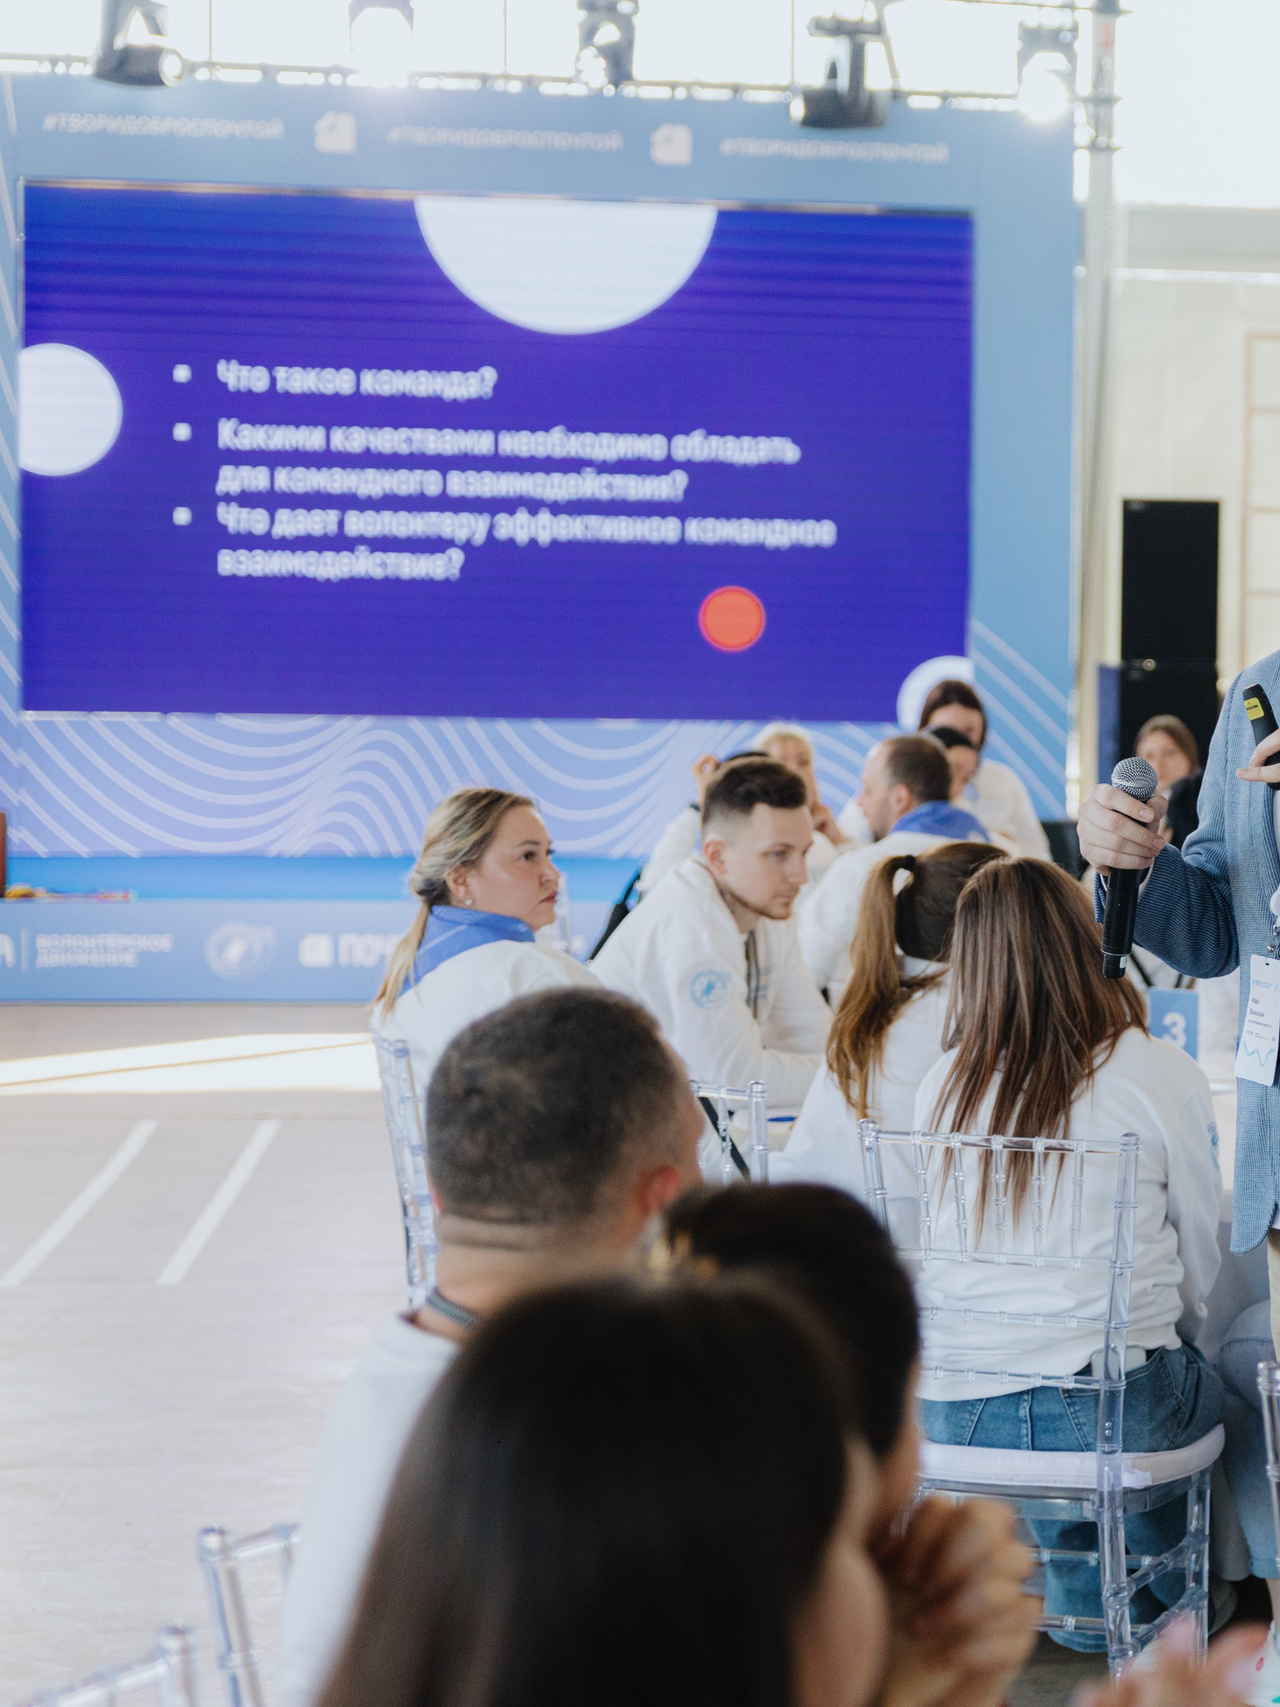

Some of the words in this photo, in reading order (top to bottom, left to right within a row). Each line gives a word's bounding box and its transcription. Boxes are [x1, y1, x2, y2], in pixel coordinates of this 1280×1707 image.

[217, 360, 270, 393] Что
[273, 366, 357, 395] такое
[360, 366, 498, 402] команда?
[218, 418, 326, 451] Какими
[330, 426, 495, 456] качествами
[498, 425, 668, 462] необходимо
[274, 467, 443, 499] командного
[217, 502, 270, 535] Что
[493, 507, 682, 547] эффективное
[684, 517, 837, 550] командное
[338, 933, 403, 968] ПОЧ
[1162, 1012, 1187, 1048] 3
